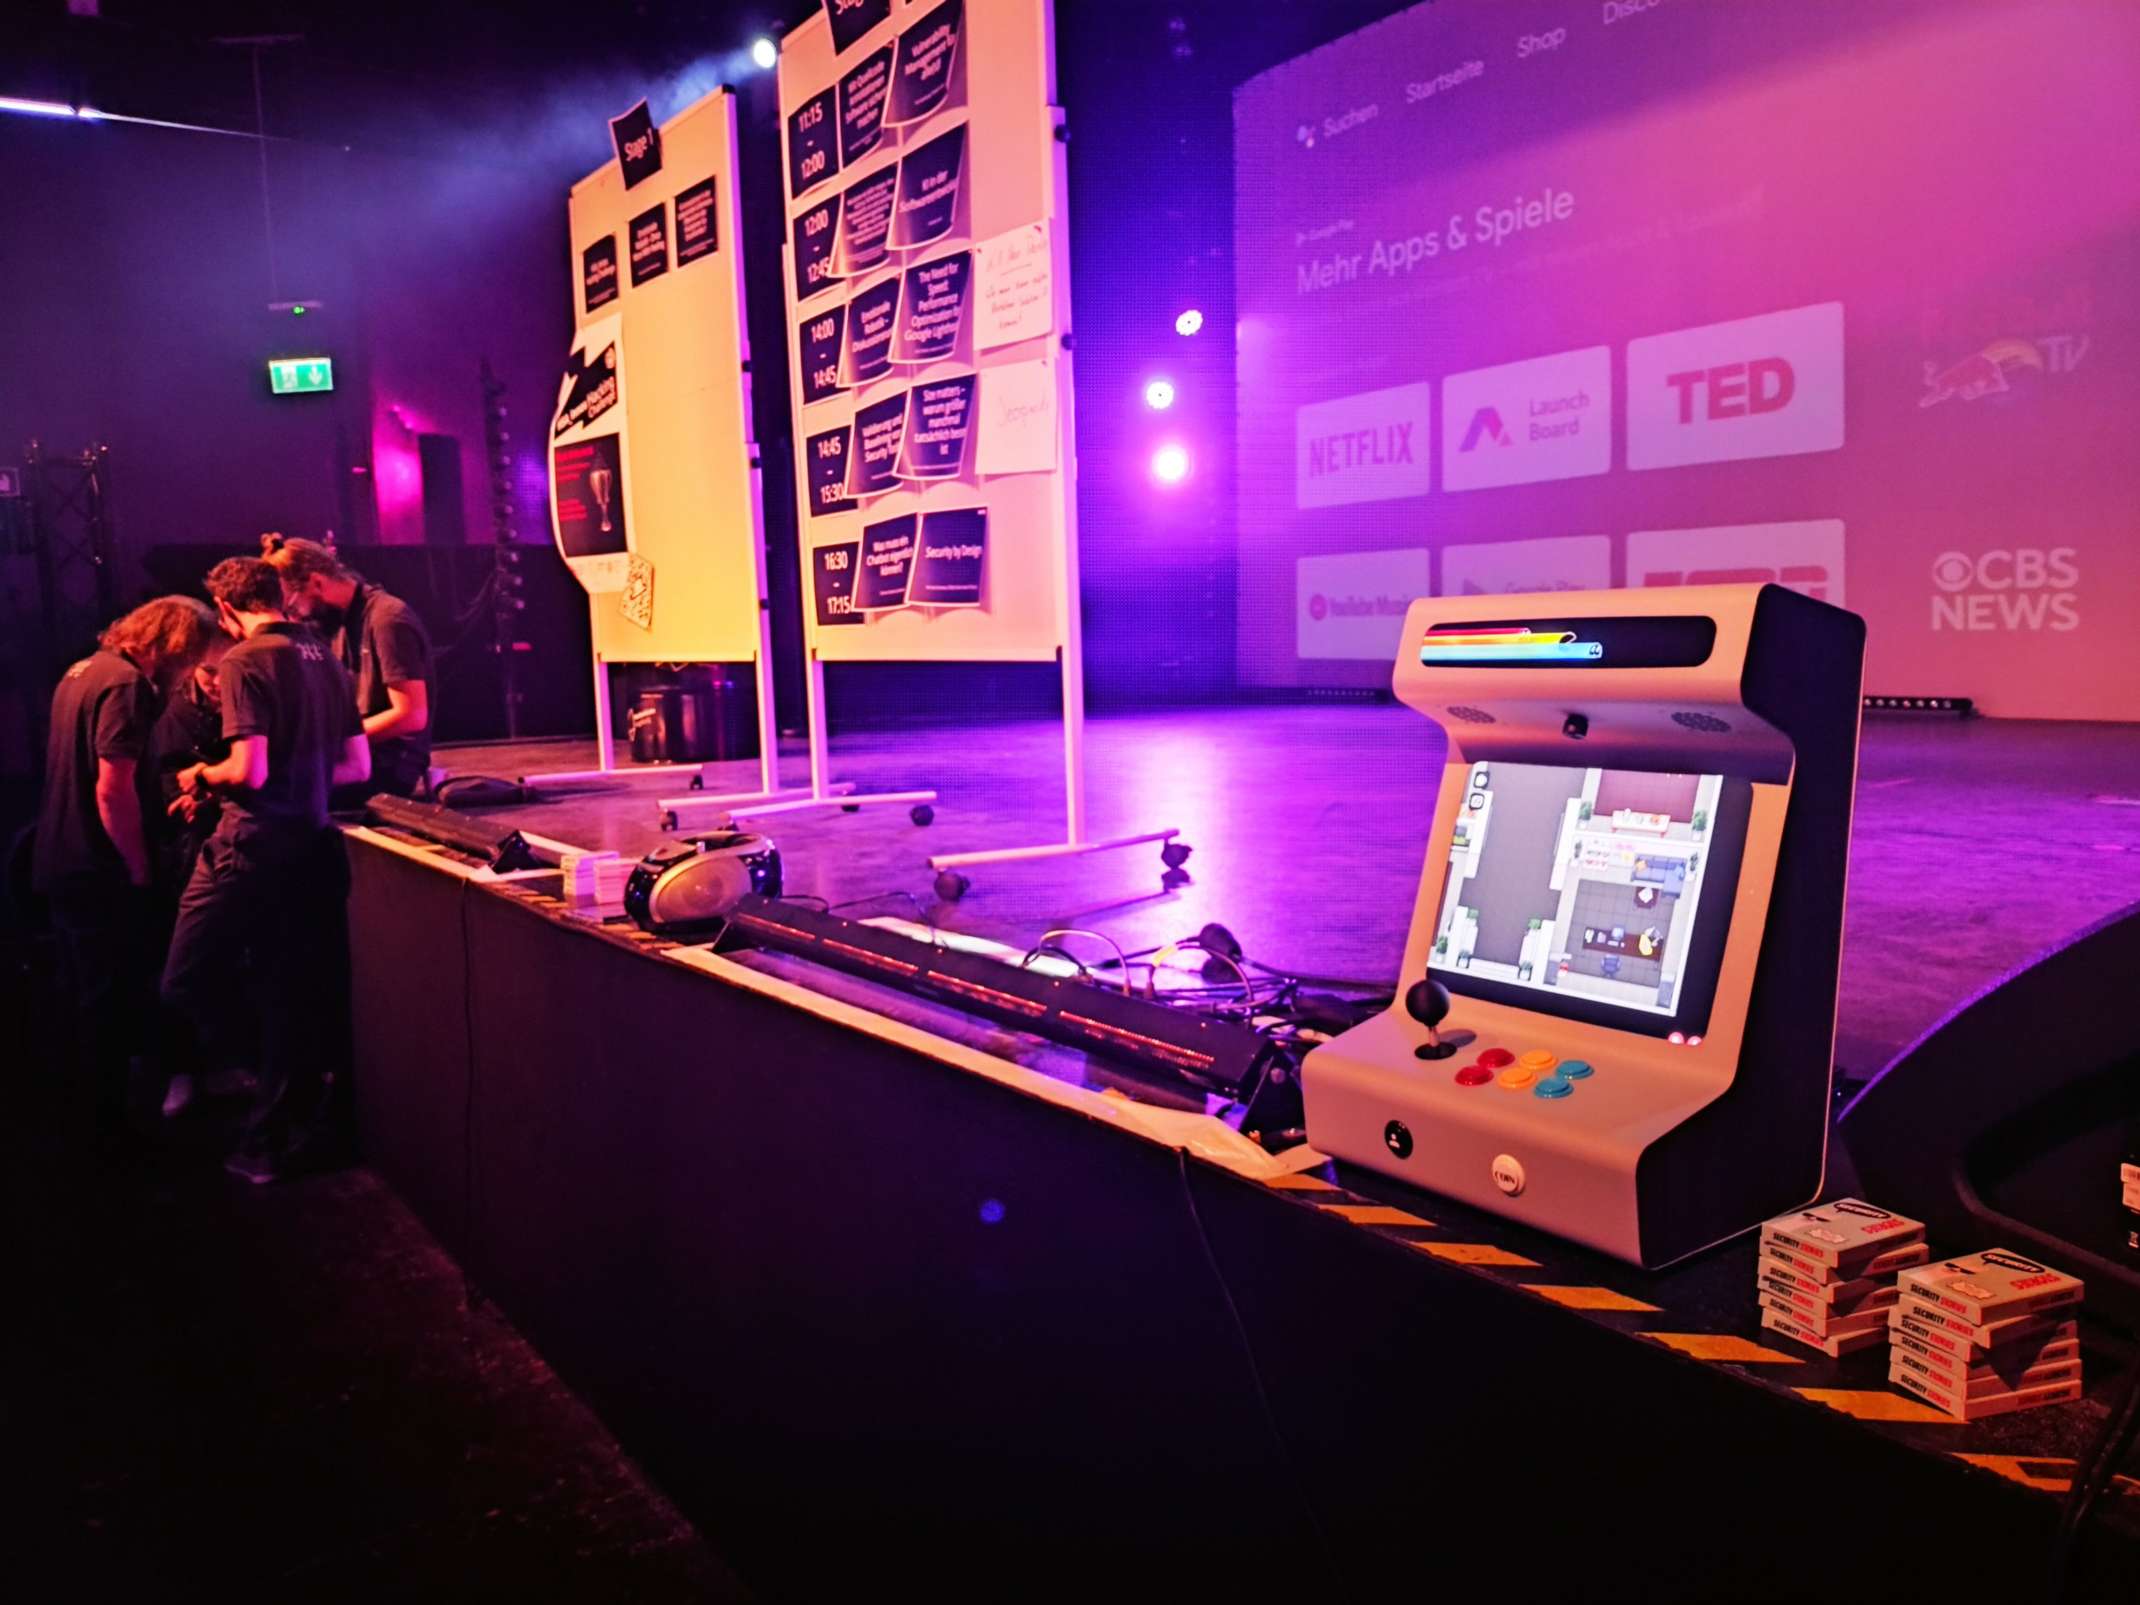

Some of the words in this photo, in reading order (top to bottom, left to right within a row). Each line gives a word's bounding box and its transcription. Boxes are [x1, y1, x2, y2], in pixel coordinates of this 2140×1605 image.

[1517, 27, 1567, 59] Shop
[1406, 60, 1485, 104] Startseite
[798, 101, 823, 132] 11:15
[1323, 104, 1379, 138] Suchen
[623, 136, 649, 162] Stage
[801, 150, 825, 180] 12:00
[804, 209, 829, 237] 12:00
[1297, 253, 1362, 294] Mehr
[1368, 229, 1440, 277] Apps
[1446, 214, 1468, 251] &
[1475, 187, 1576, 247] Spiele
[811, 317, 835, 343] 14:00
[2040, 334, 2091, 373] TV
[813, 364, 836, 389] 14:45
[1667, 356, 1796, 425] TED
[1529, 391, 1590, 418] Launch
[1529, 416, 1580, 442] Board
[817, 436, 842, 459] 14:45
[1309, 422, 1414, 478] NETFLIX
[820, 482, 844, 504] 15:30
[824, 550, 849, 571] 16:30
[925, 546, 953, 561] Security
[961, 544, 982, 559] Design
[1976, 547, 2079, 590] CBS
[827, 596, 850, 616] 17:15
[1931, 593, 2080, 632] NEWS
[1773, 1232, 1800, 1248] SECURITY
[1770, 1248, 1793, 1264] SECURITY
[1770, 1267, 1796, 1283] SECURITY
[1769, 1281, 1793, 1297] SECURITY
[1910, 1284, 1940, 1302] SECURITY
[1770, 1299, 1793, 1315] SECURITY
[1913, 1306, 1945, 1325] SECURITY
[1773, 1319, 1800, 1335] SECURITY
[1901, 1319, 1930, 1338] SECURITY
[1901, 1337, 1928, 1355] SECURITY
[1902, 1355, 1929, 1374] SECURITY
[1901, 1374, 1927, 1394] SECURITY
